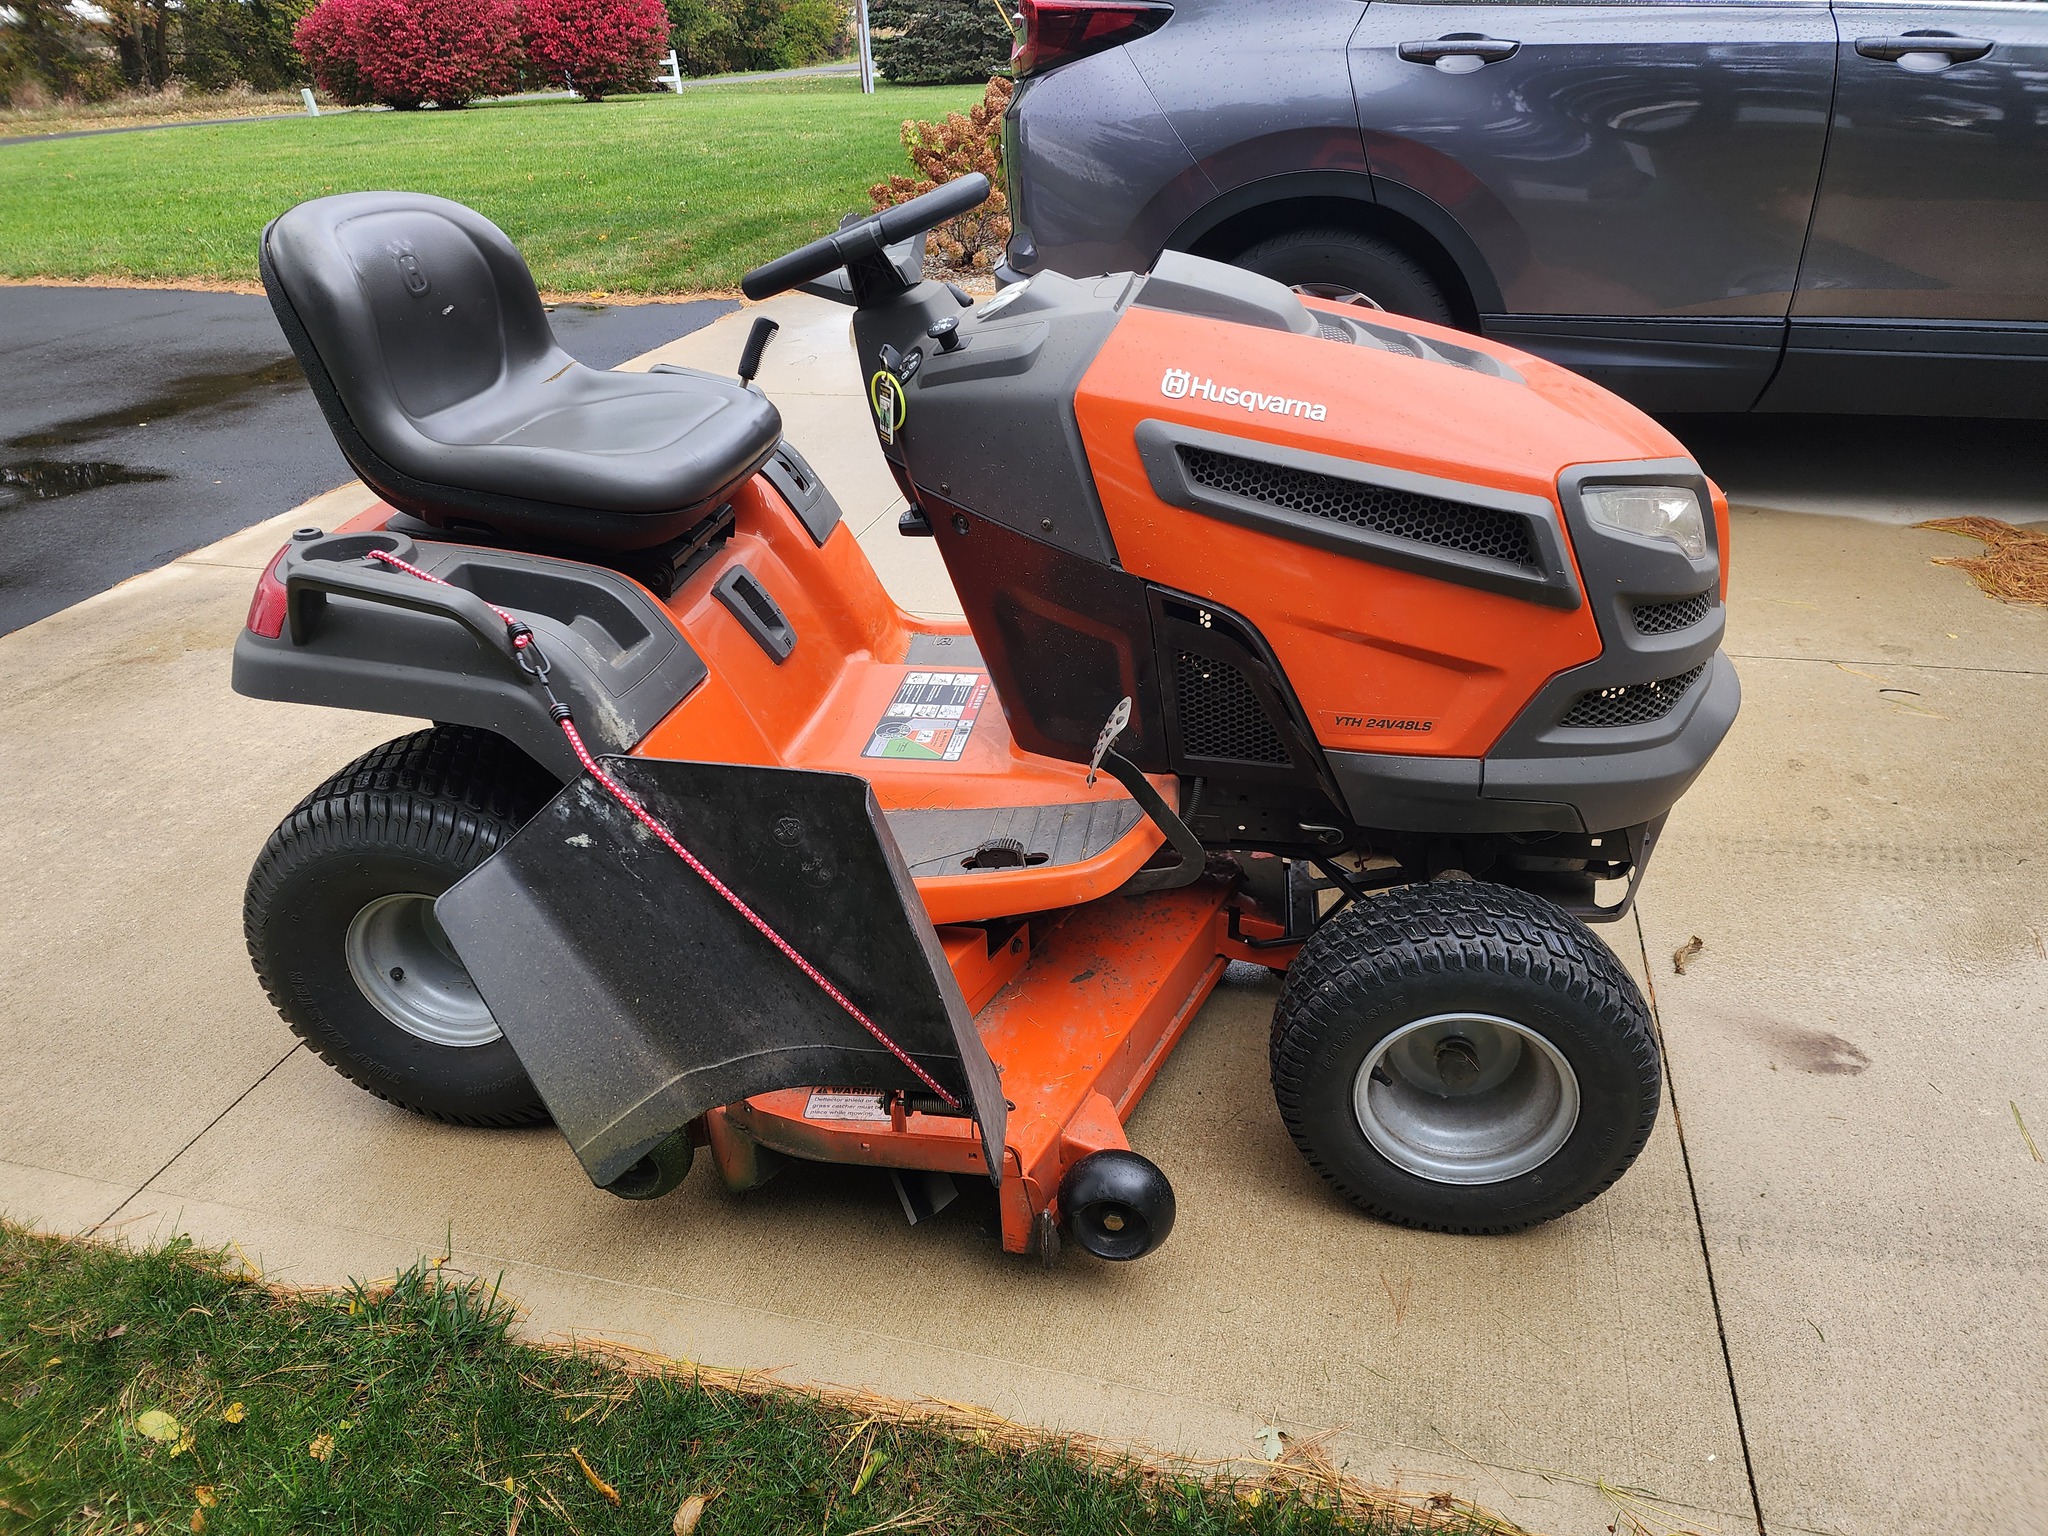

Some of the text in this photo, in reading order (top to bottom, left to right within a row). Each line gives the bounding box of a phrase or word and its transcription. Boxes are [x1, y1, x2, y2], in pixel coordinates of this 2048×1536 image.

[1189, 376, 1328, 422] Husqvarna
[1335, 715, 1433, 731] YTH 24V48LS
[291, 971, 402, 1085] TURF MASTER
[832, 1087, 885, 1096] WARNIN
